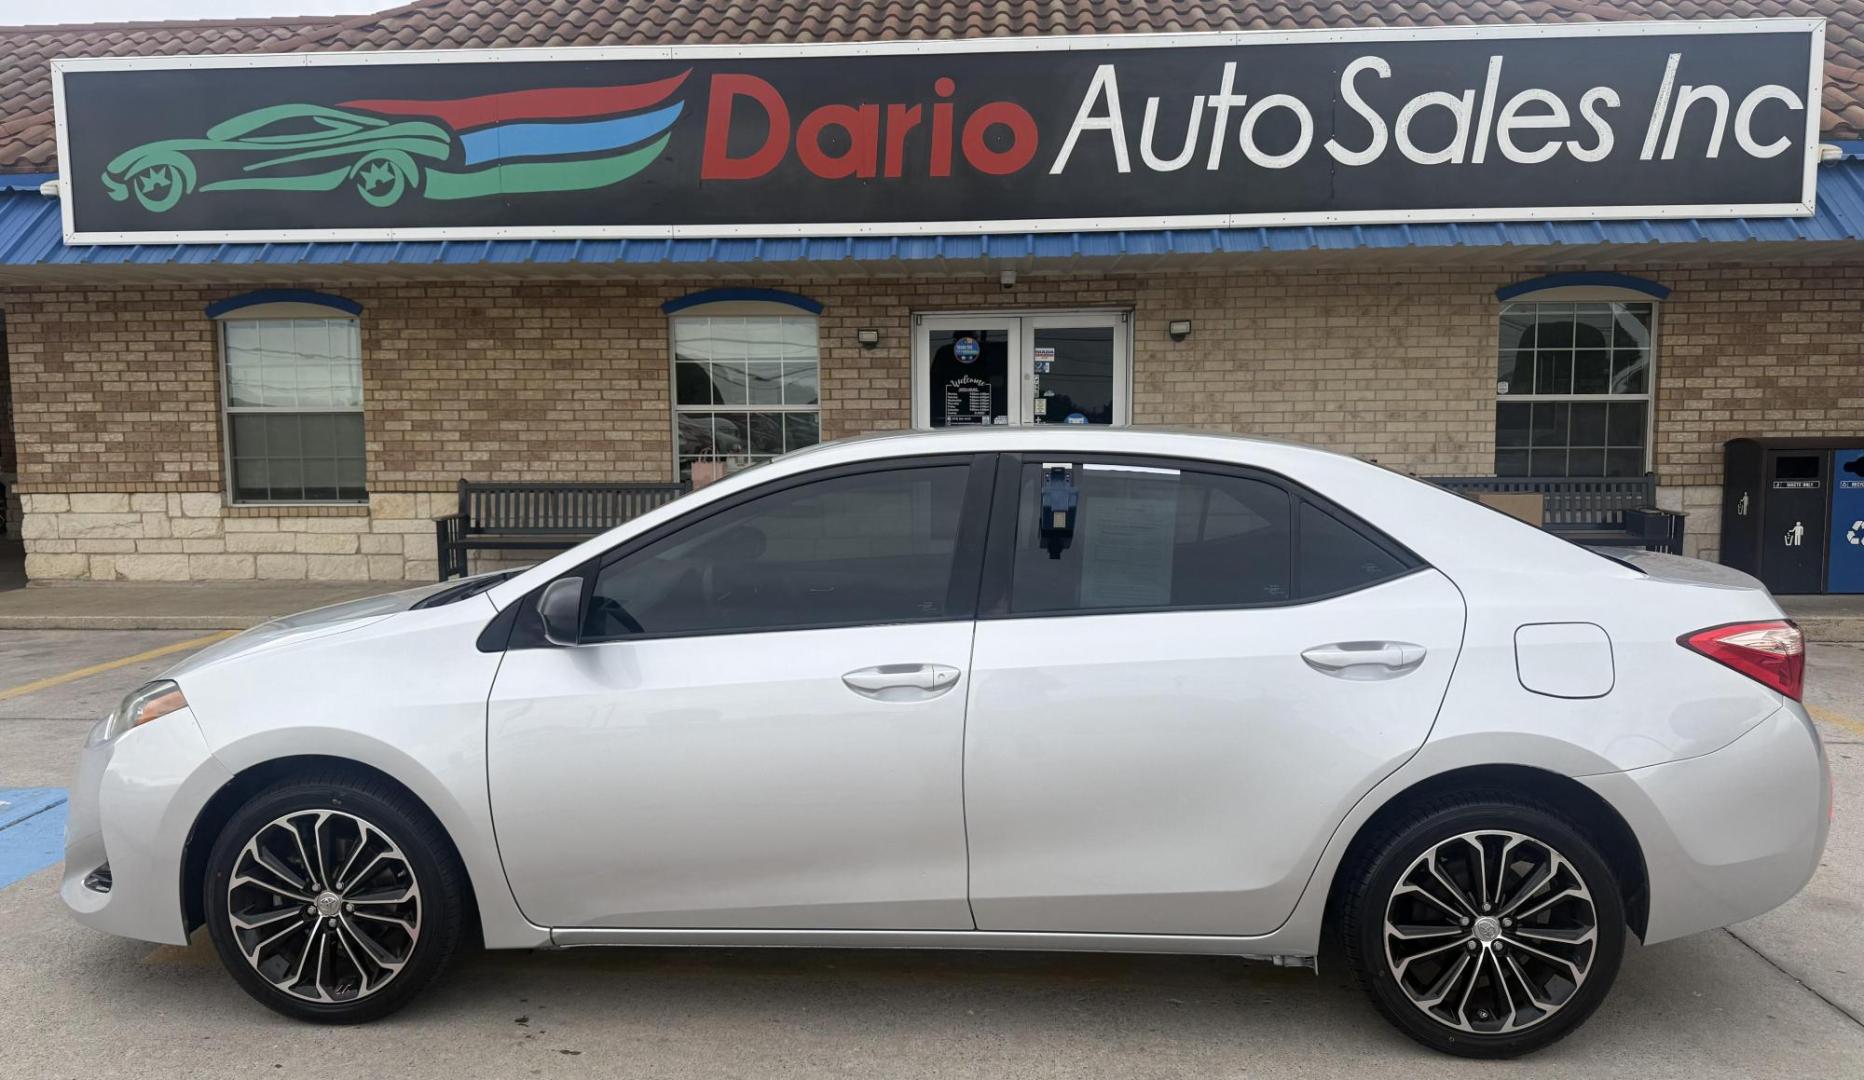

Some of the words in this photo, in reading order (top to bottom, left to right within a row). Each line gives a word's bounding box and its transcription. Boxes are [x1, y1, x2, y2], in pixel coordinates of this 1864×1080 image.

[701, 73, 1038, 180] Dario
[1049, 61, 1314, 175] Auto
[1323, 54, 1621, 166] Sales
[1639, 52, 1804, 161] Inc
[950, 374, 986, 388] Welcome
